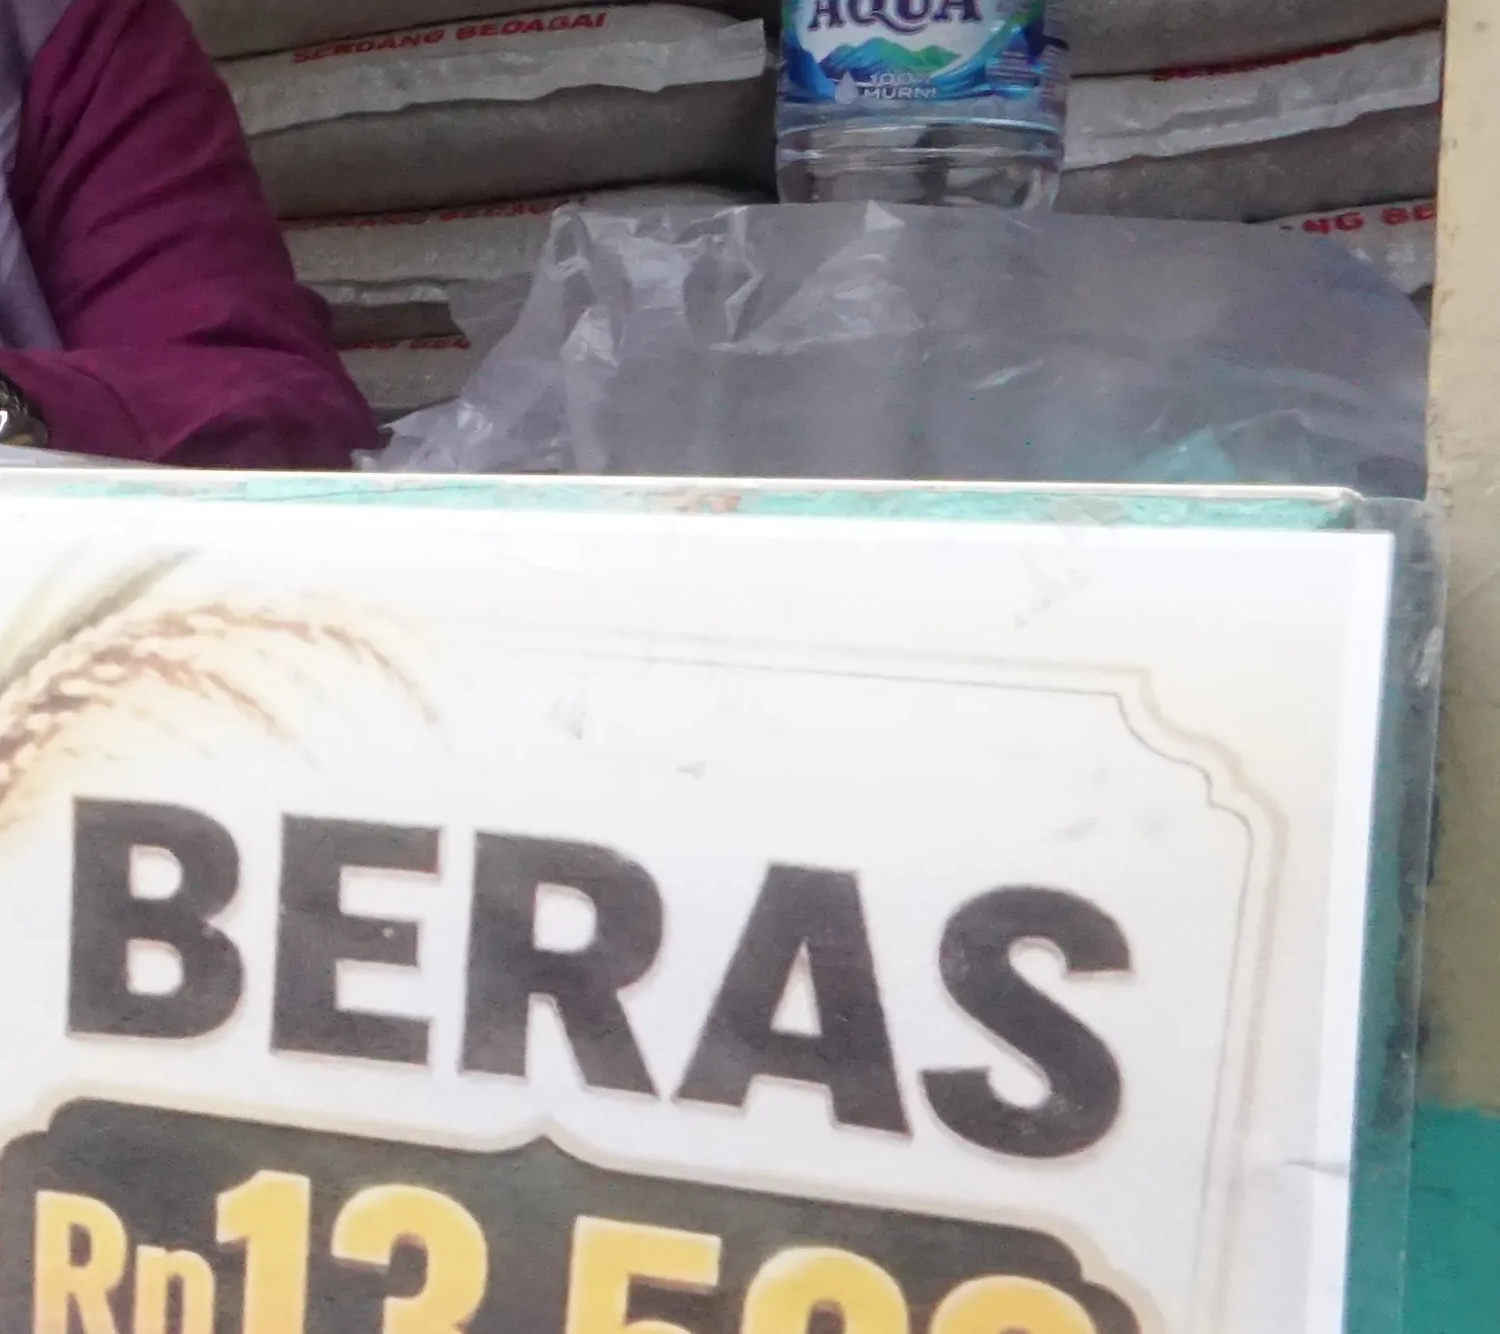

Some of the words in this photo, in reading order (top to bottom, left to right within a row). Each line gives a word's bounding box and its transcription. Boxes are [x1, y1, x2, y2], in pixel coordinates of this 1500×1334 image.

[292, 30, 445, 64] SERDANG
[455, 12, 608, 41] BEDAGAI
[861, 86, 937, 100] MURNI
[64, 796, 1135, 1161] BERAS
